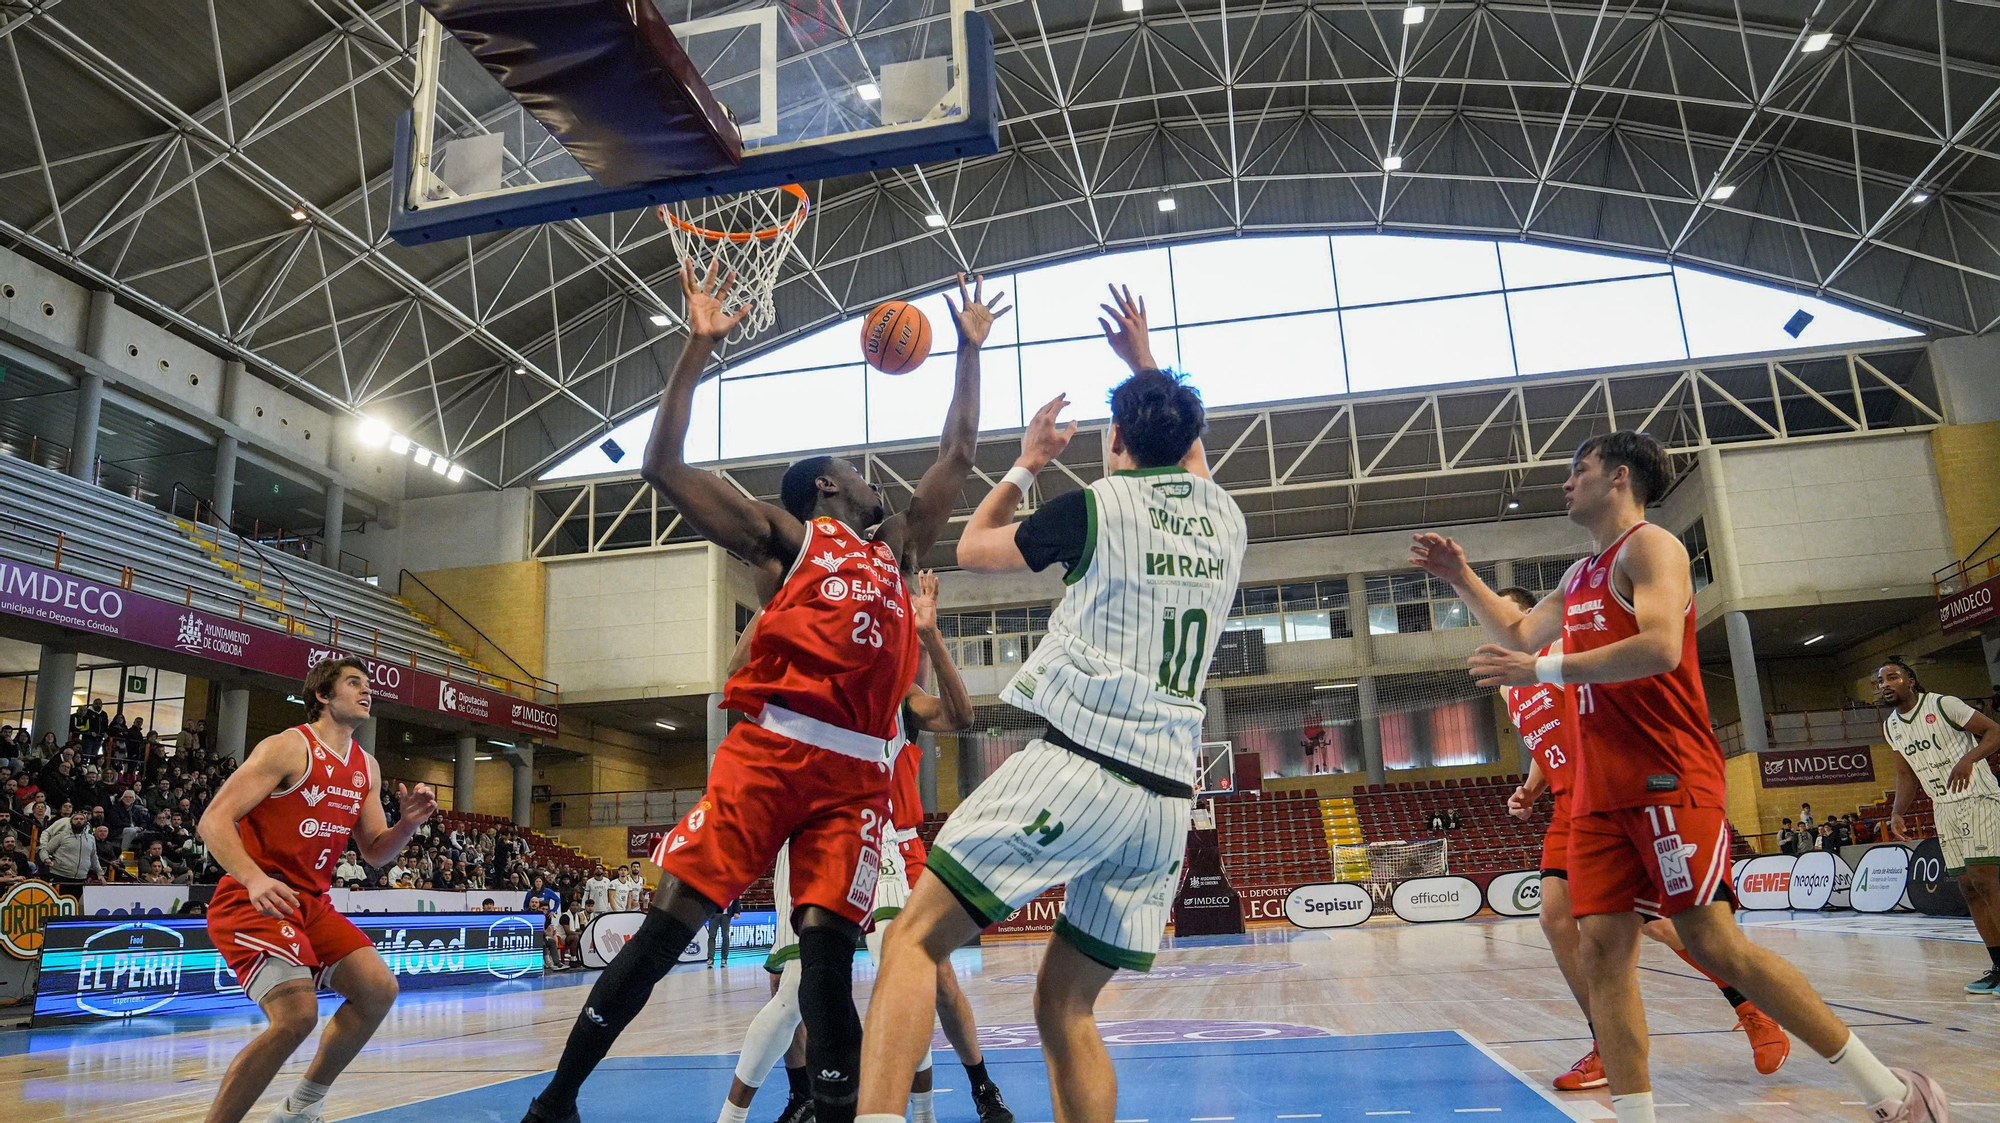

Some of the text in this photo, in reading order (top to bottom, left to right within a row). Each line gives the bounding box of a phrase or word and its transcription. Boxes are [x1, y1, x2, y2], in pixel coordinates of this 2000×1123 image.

[868, 308, 897, 354] Wilson
[1178, 555, 1224, 581] RAHI
[0, 563, 123, 619] IMDECO
[1950, 587, 1991, 618] IMDECO
[36, 608, 47, 618] de
[49, 610, 86, 627] Deportes
[87, 619, 119, 634] Córdoba
[851, 611, 883, 648] 25
[204, 623, 250, 646] AYUNTAMIENTO
[203, 637, 243, 657] DE CÓRDOBA
[1158, 607, 1208, 698] 10
[133, 679, 142, 691] D
[458, 691, 489, 707] Diputación
[458, 701, 489, 718] de Córdoba
[1576, 682, 1595, 715] 11
[522, 705, 558, 727] IMDECO
[1528, 718, 1561, 741] E.Leclerc
[1544, 744, 1567, 769] 23
[1787, 753, 1868, 774] IMDECO
[320, 821, 351, 835] E.Leclerc
[1644, 805, 1677, 836] 11
[314, 848, 332, 870] 5
[1520, 885, 1540, 899] CS
[1793, 873, 1830, 896] neogare
[1194, 896, 1230, 905] IMDECO
[1304, 898, 1364, 916] Sepisur
[1410, 890, 1459, 905] efficold
[129, 934, 144, 945] Food
[998, 925, 1024, 933] Instituto
[78, 954, 107, 990] EL
[112, 994, 146, 1006] Experience
